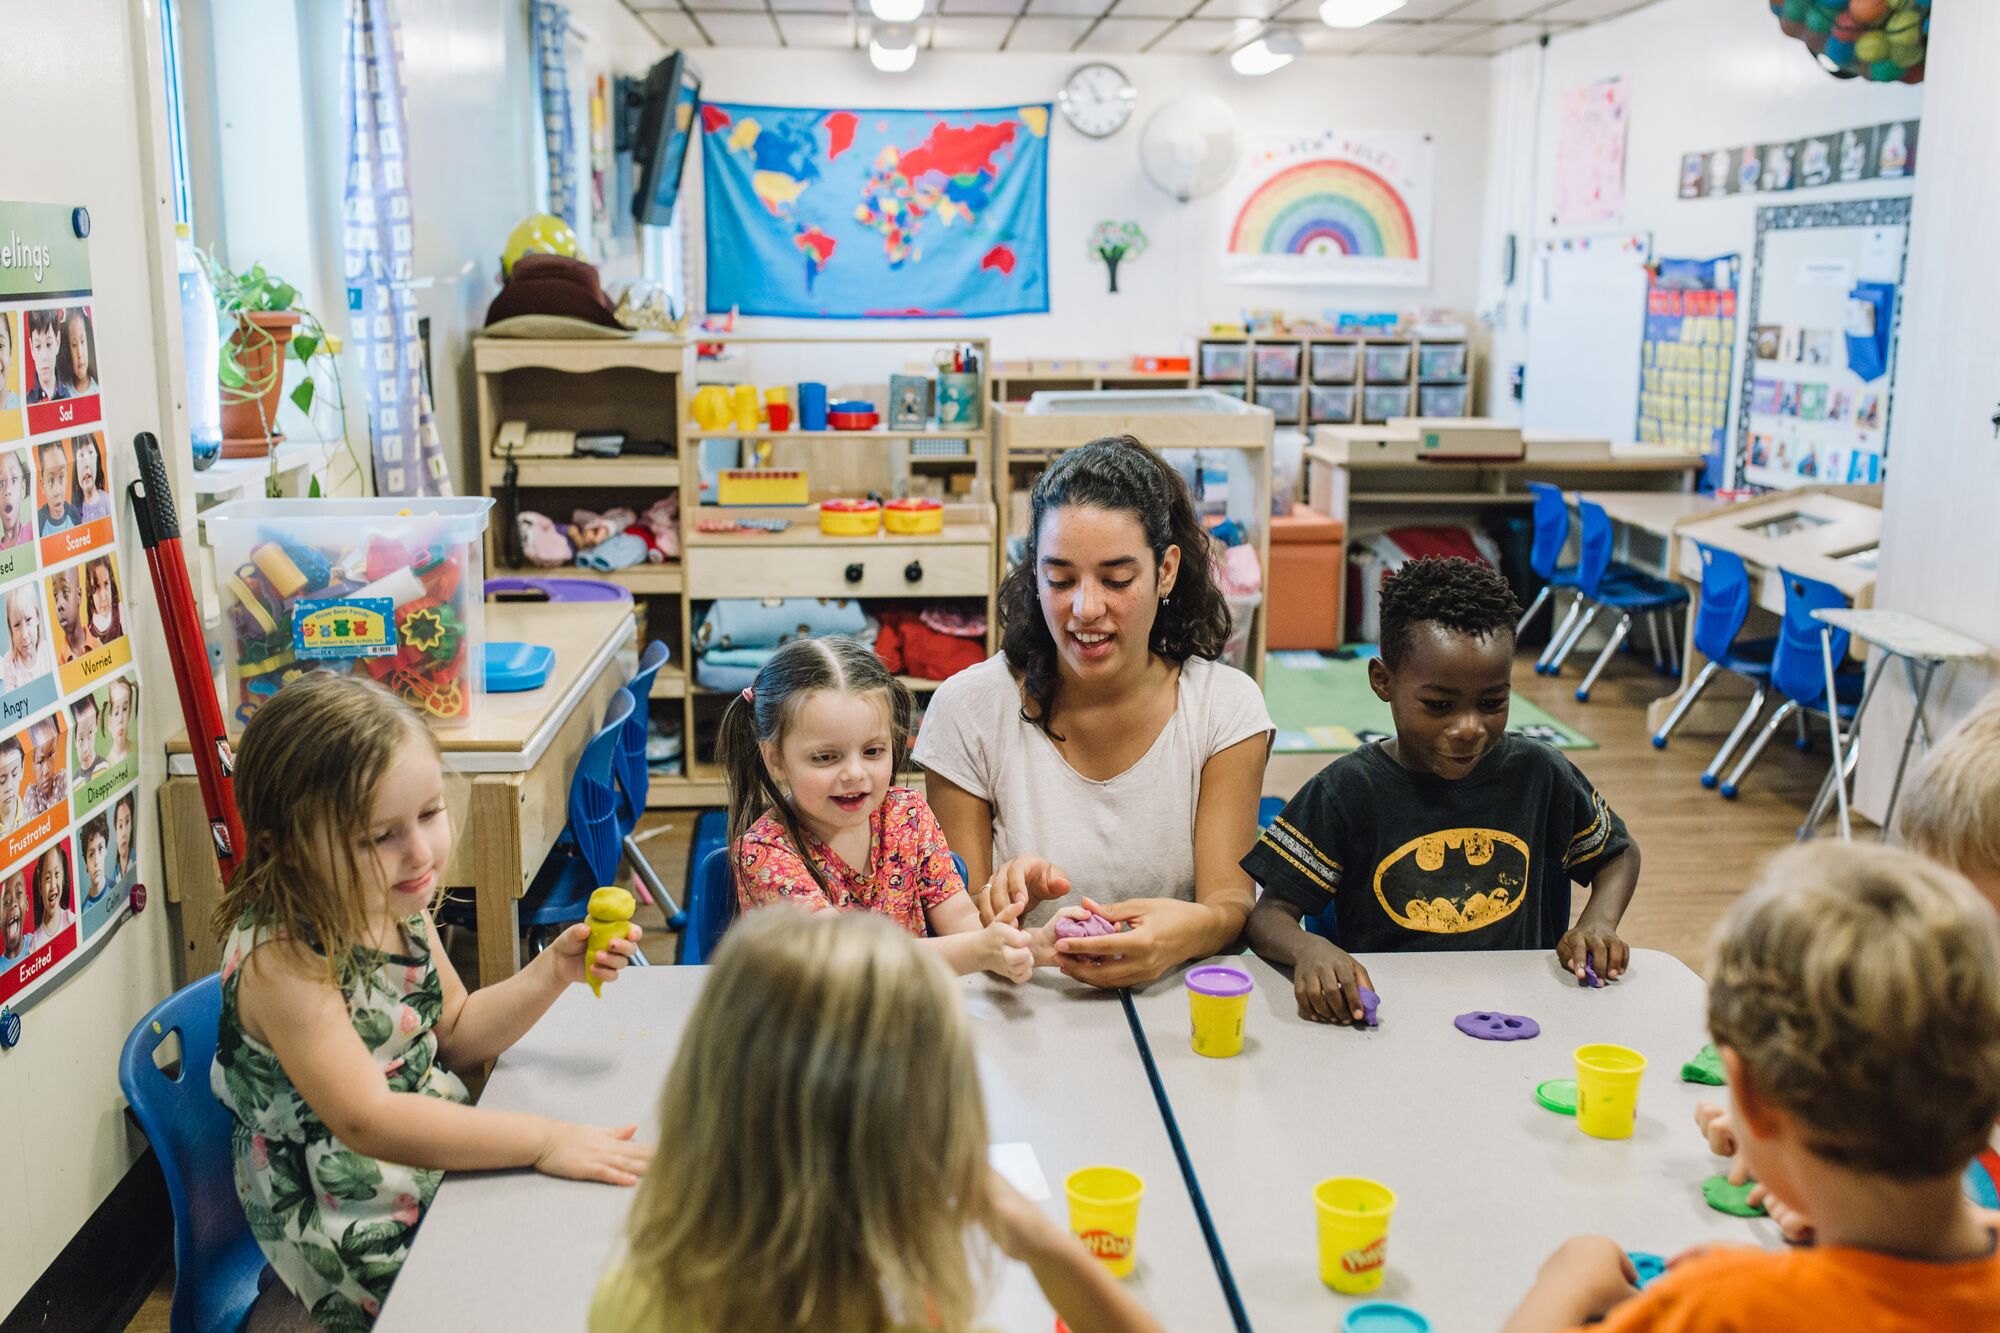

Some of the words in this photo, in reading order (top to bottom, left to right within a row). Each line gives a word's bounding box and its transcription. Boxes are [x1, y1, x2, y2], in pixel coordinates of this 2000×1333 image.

[59, 403, 73, 422] Sad
[65, 527, 92, 552] Scared
[0, 554, 14, 575] sed
[81, 649, 112, 677] Worried
[3, 697, 29, 719] Angry
[87, 763, 129, 804] Disappointed
[9, 815, 51, 857] Frustrated
[20, 945, 52, 983] Excited
